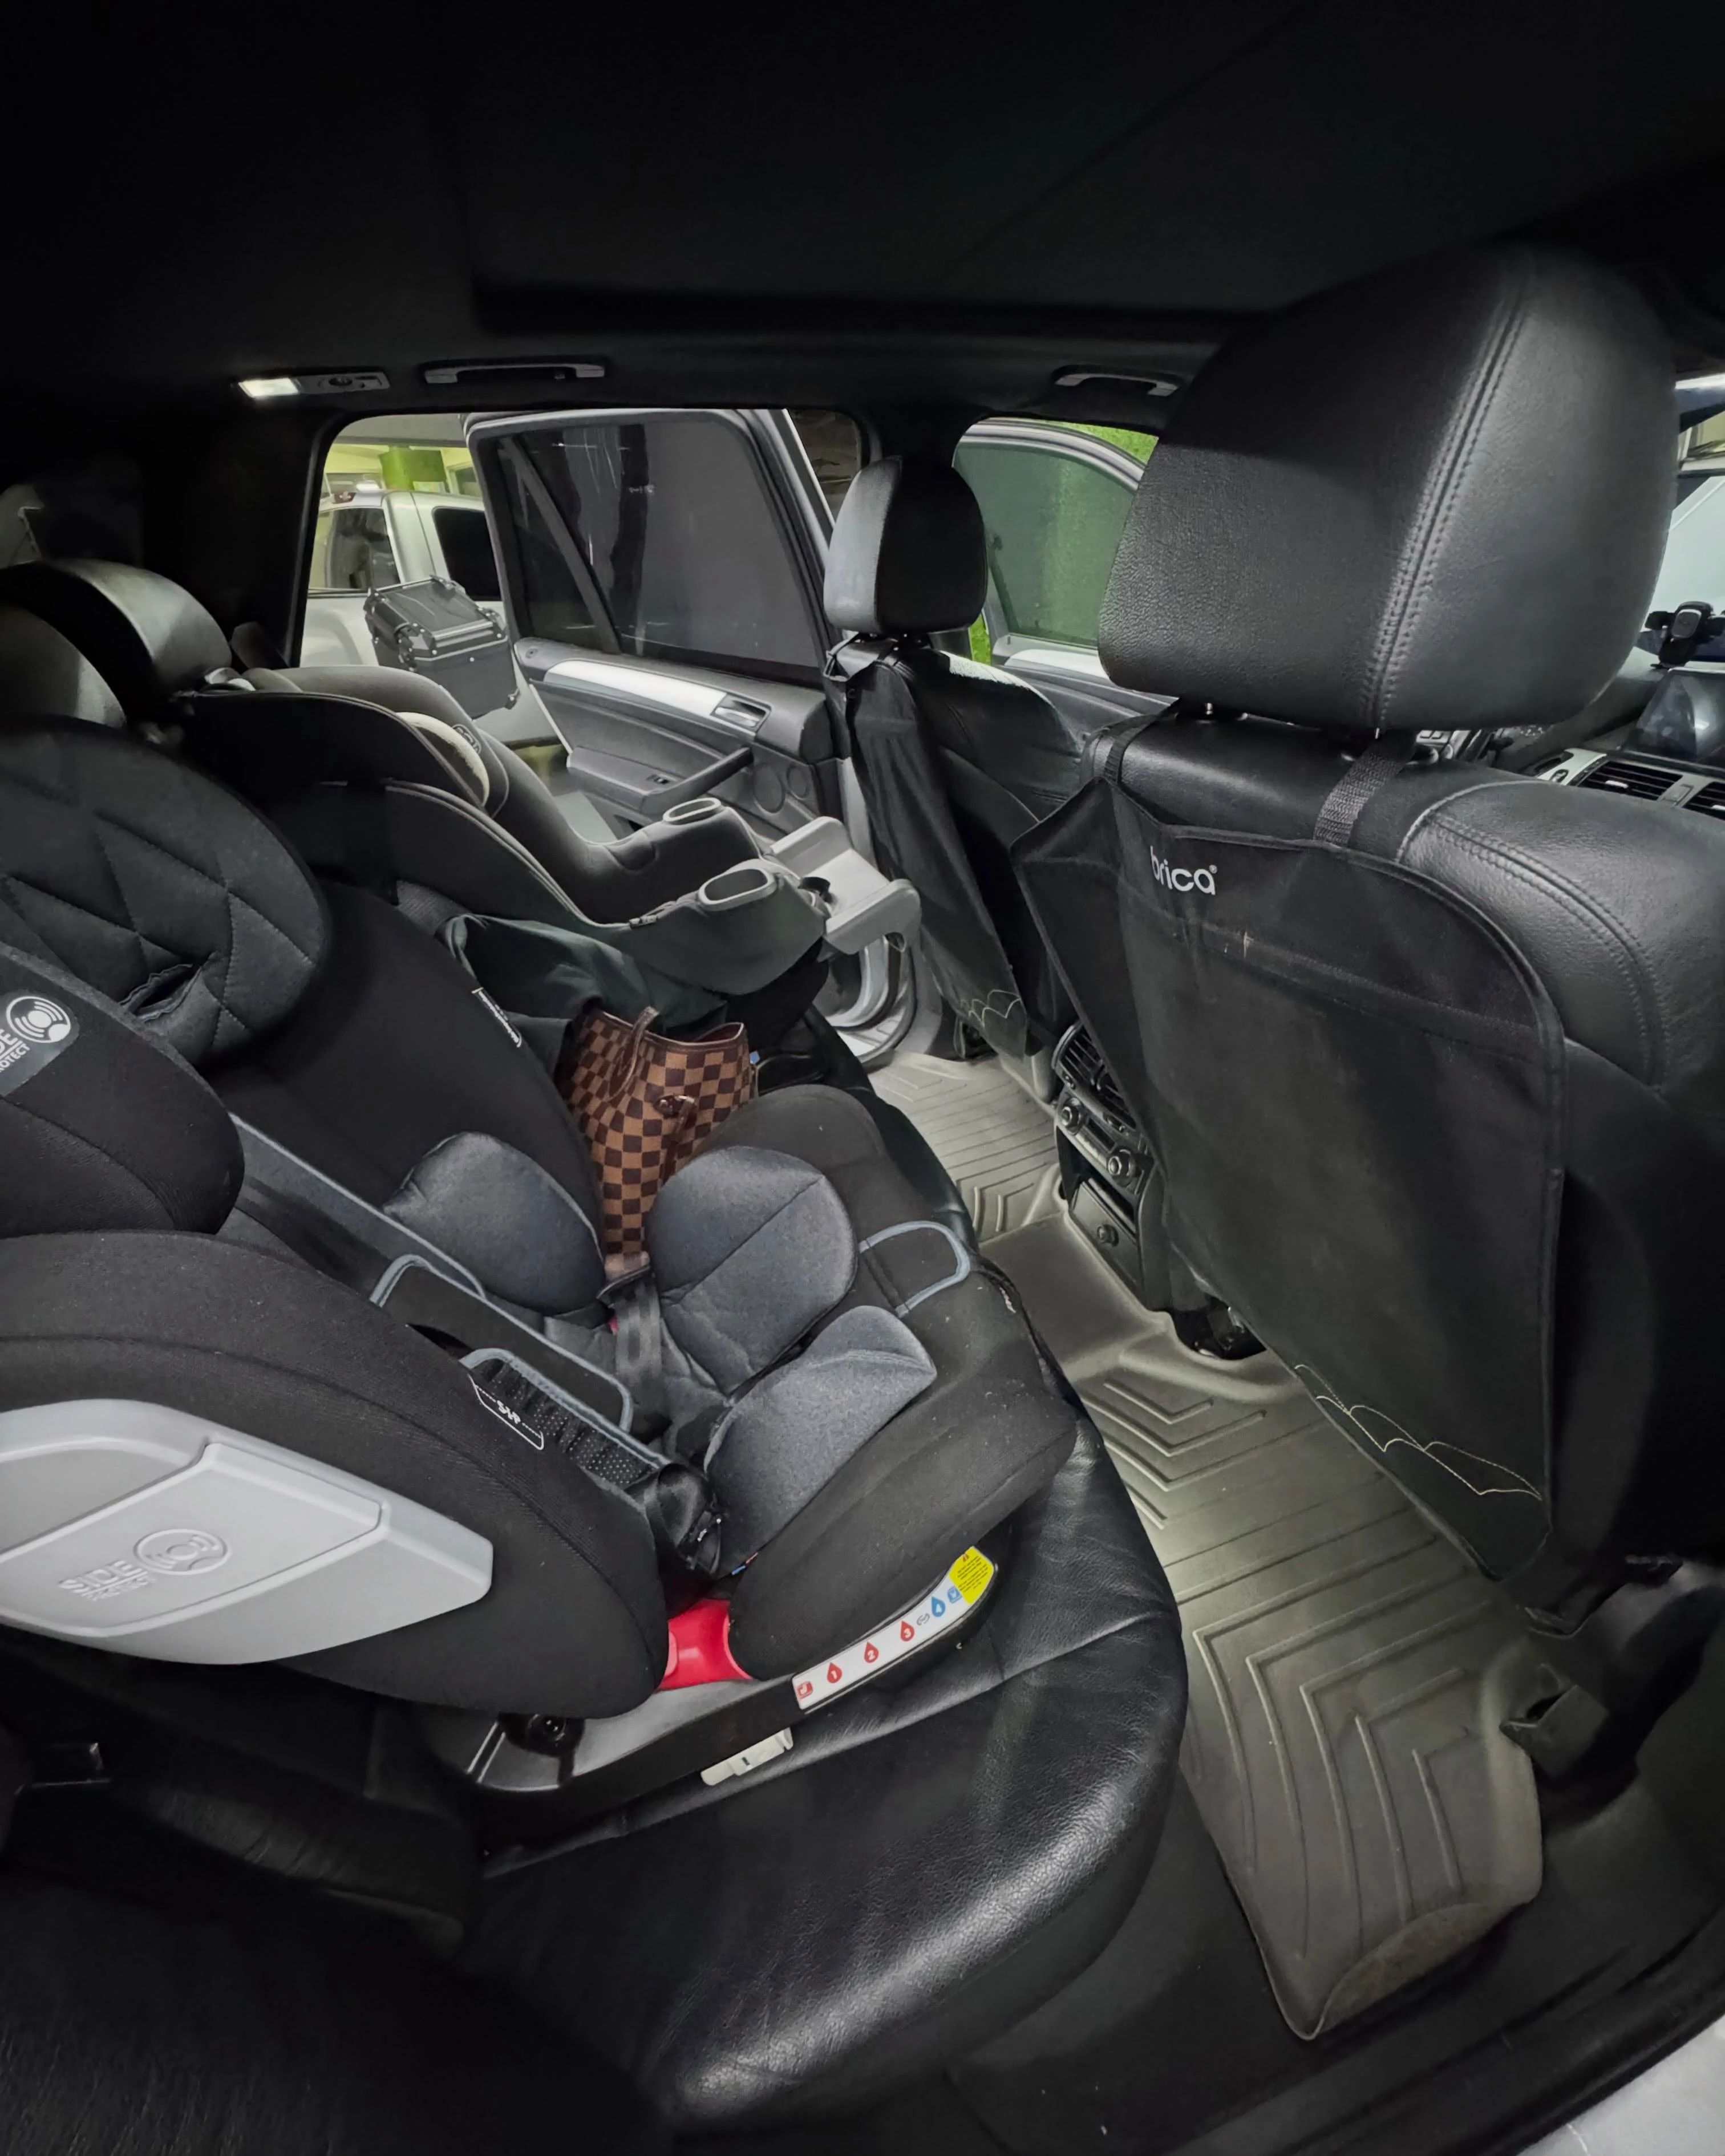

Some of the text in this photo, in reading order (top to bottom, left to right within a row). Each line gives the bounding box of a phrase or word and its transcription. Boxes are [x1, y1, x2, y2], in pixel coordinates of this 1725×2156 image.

[831, 1670, 837, 1680] 1
[868, 1650, 876, 1660] 2
[904, 1628, 912, 1639] 3
